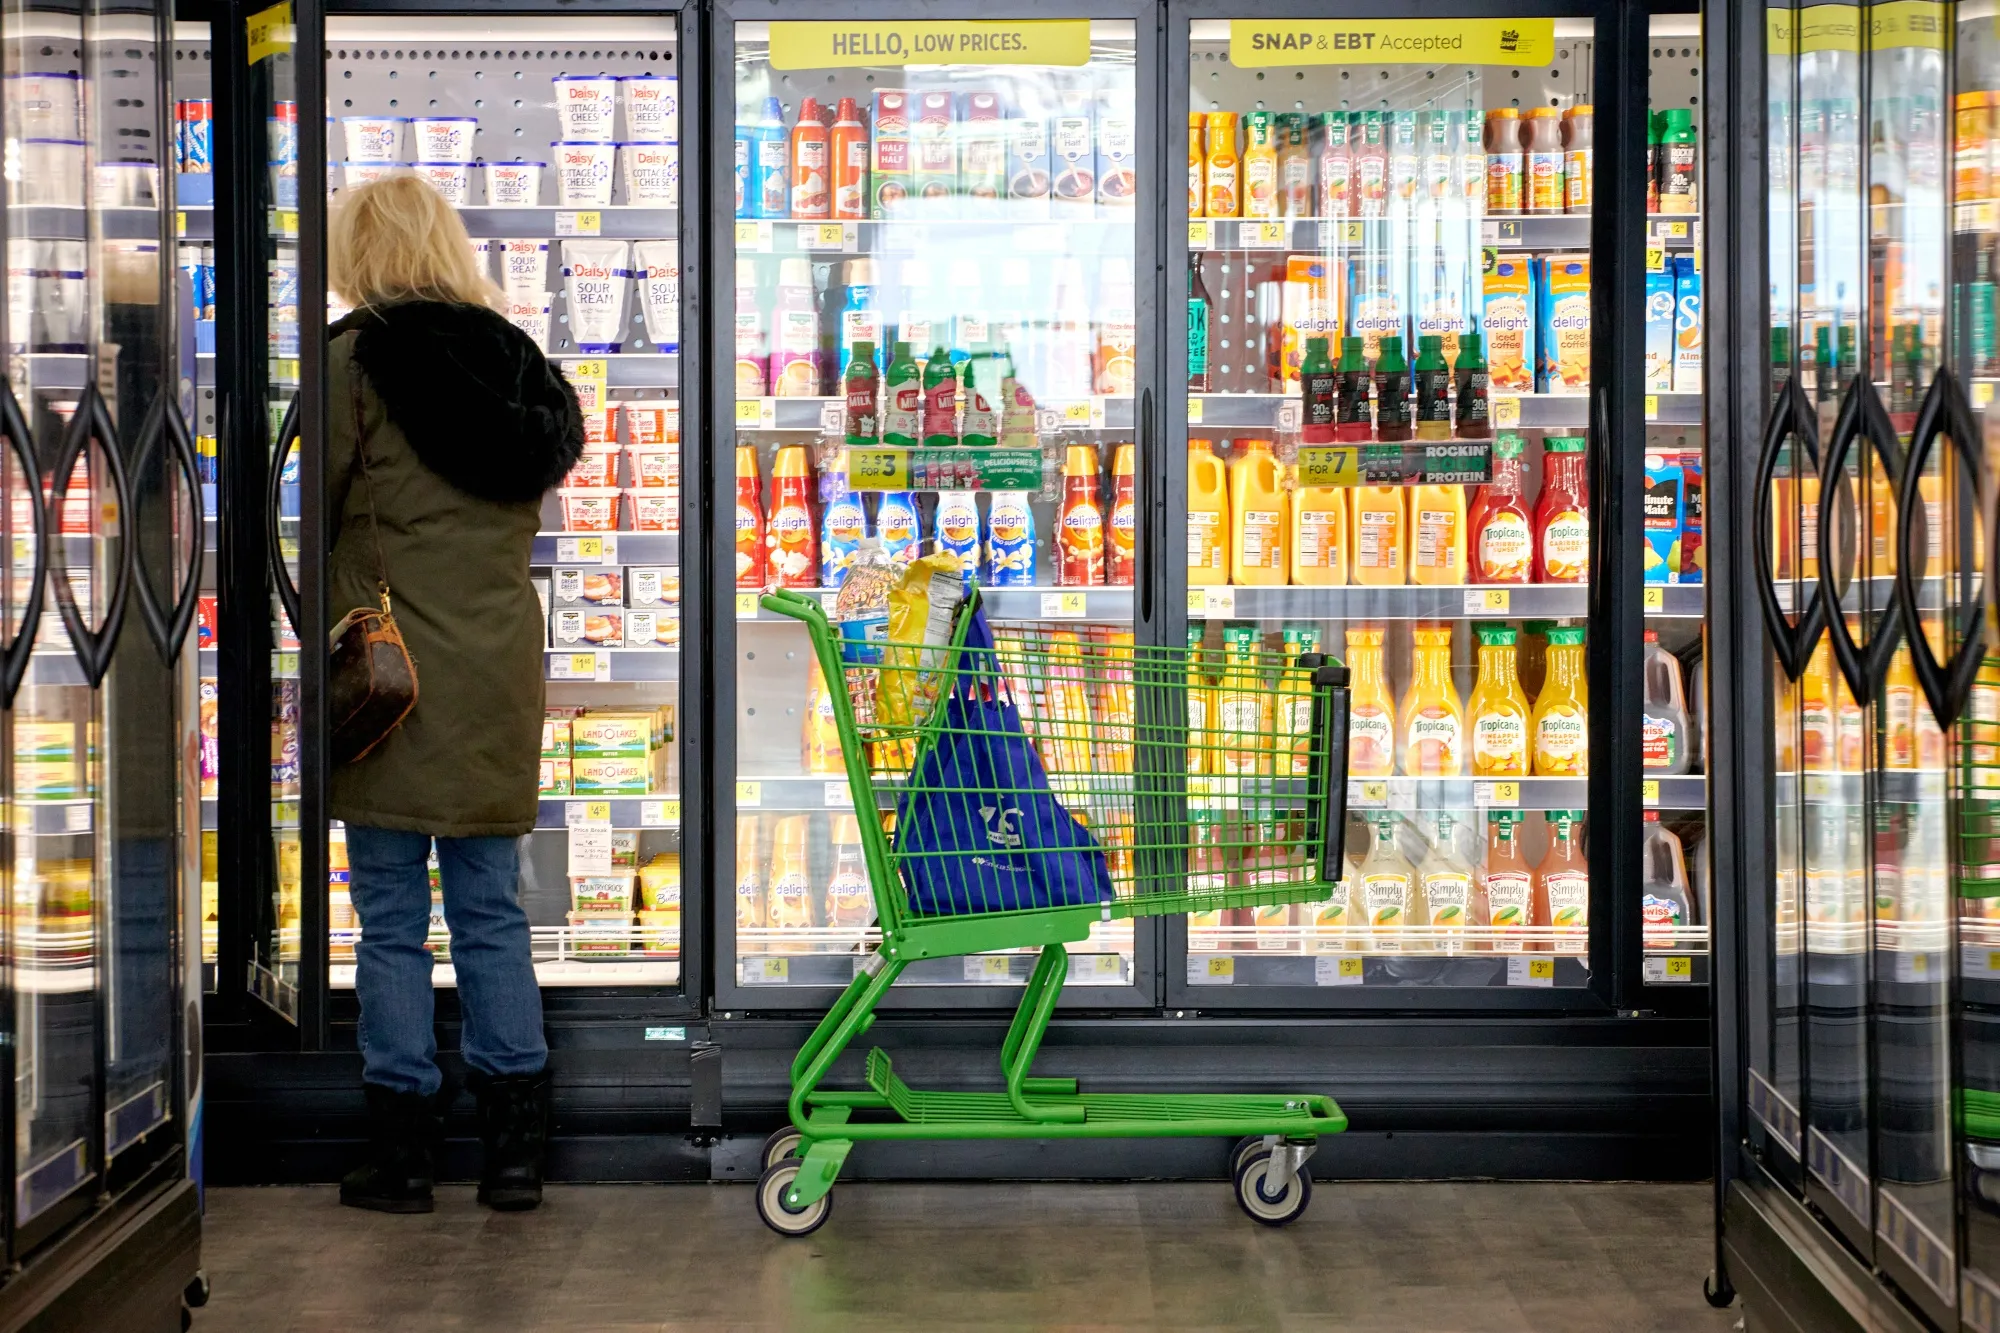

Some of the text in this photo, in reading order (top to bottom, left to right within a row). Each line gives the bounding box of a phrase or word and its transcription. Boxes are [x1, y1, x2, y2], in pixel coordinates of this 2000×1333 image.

[832, 32, 1028, 58] HELLO, LOW PRICES.
[1252, 32, 1463, 53] SNAP & EBT Accepted
[569, 86, 600, 100] Daisy
[565, 104, 598, 112] COTTAGE
[571, 113, 600, 122] CHEESE
[359, 124, 382, 134] Daisy
[427, 123, 452, 134] Daisy
[881, 144, 904, 153] HALF
[1064, 139, 1081, 147] Half
[1109, 139, 1127, 147] Half
[565, 151, 595, 165] Daisy
[638, 151, 669, 165] Daisy
[881, 156, 905, 164] HALF
[924, 155, 947, 164] HALF
[430, 168, 456, 180] Daisy
[495, 168, 520, 180] Daisy
[559, 169, 591, 177] COTTAGE
[633, 169, 667, 177] COTTAGE
[1488, 165, 1511, 173] Swiss
[567, 178, 596, 186] CHEESE
[639, 178, 670, 186] CHEESE
[1503, 223, 1515, 236] $1
[509, 240, 537, 254] Daisy
[510, 257, 536, 266] SOUR
[1649, 250, 1663, 264] $7
[574, 262, 612, 280] Daisy
[648, 263, 679, 280] Dais
[577, 283, 610, 294] SOUR
[652, 284, 678, 295] SOU
[575, 294, 614, 304] CREAM
[650, 294, 678, 305] CREA
[1294, 318, 1338, 332] delight
[1356, 318, 1400, 332] delight
[1419, 318, 1464, 332] delight
[1483, 317, 1528, 331] delight
[1553, 316, 1590, 330] deligh
[1496, 332, 1516, 341] iced
[1565, 332, 1586, 341] iced
[1490, 341, 1521, 349] coffee
[578, 366, 588, 375] $3
[849, 397, 872, 407] MILK
[900, 398, 919, 409] MIL
[1426, 446, 1489, 457] ROCKIN'
[861, 455, 896, 477] 2 $3
[1309, 452, 1347, 474] 3 $7
[1426, 458, 1486, 471] GOOD
[861, 467, 879, 476] FOR
[1309, 466, 1328, 474] FOR
[1427, 472, 1485, 482] PROTEIN
[773, 517, 809, 529] delight
[827, 517, 864, 529] delight
[877, 517, 913, 529] delight
[989, 515, 1026, 527] delight
[1065, 514, 1101, 527] delight
[1485, 527, 1525, 540] Tropicana
[1550, 527, 1589, 540] Tropicana
[942, 535, 974, 545] ZERO SUGAR
[1489, 592, 1502, 605] $3
[1648, 592, 1655, 602] 2
[1349, 720, 1387, 732] Tropicana
[1415, 721, 1454, 733] Tropicana
[1480, 720, 1519, 732] Tropicana
[1541, 720, 1580, 732] Tropicana
[616, 730, 637, 738] LAKES
[617, 768, 638, 776] LAKES
[1499, 785, 1512, 797] $3
[829, 884, 867, 896] delight
[1369, 882, 1403, 899] Simply
[1429, 882, 1464, 899] Simply
[1490, 882, 1524, 899] Simply
[1551, 882, 1585, 899] Simply
[1368, 897, 1403, 908] Lemonade
[1430, 896, 1465, 908] Lemonade
[1490, 896, 1526, 908] Lemonade
[1551, 896, 1586, 908] Lemonade
